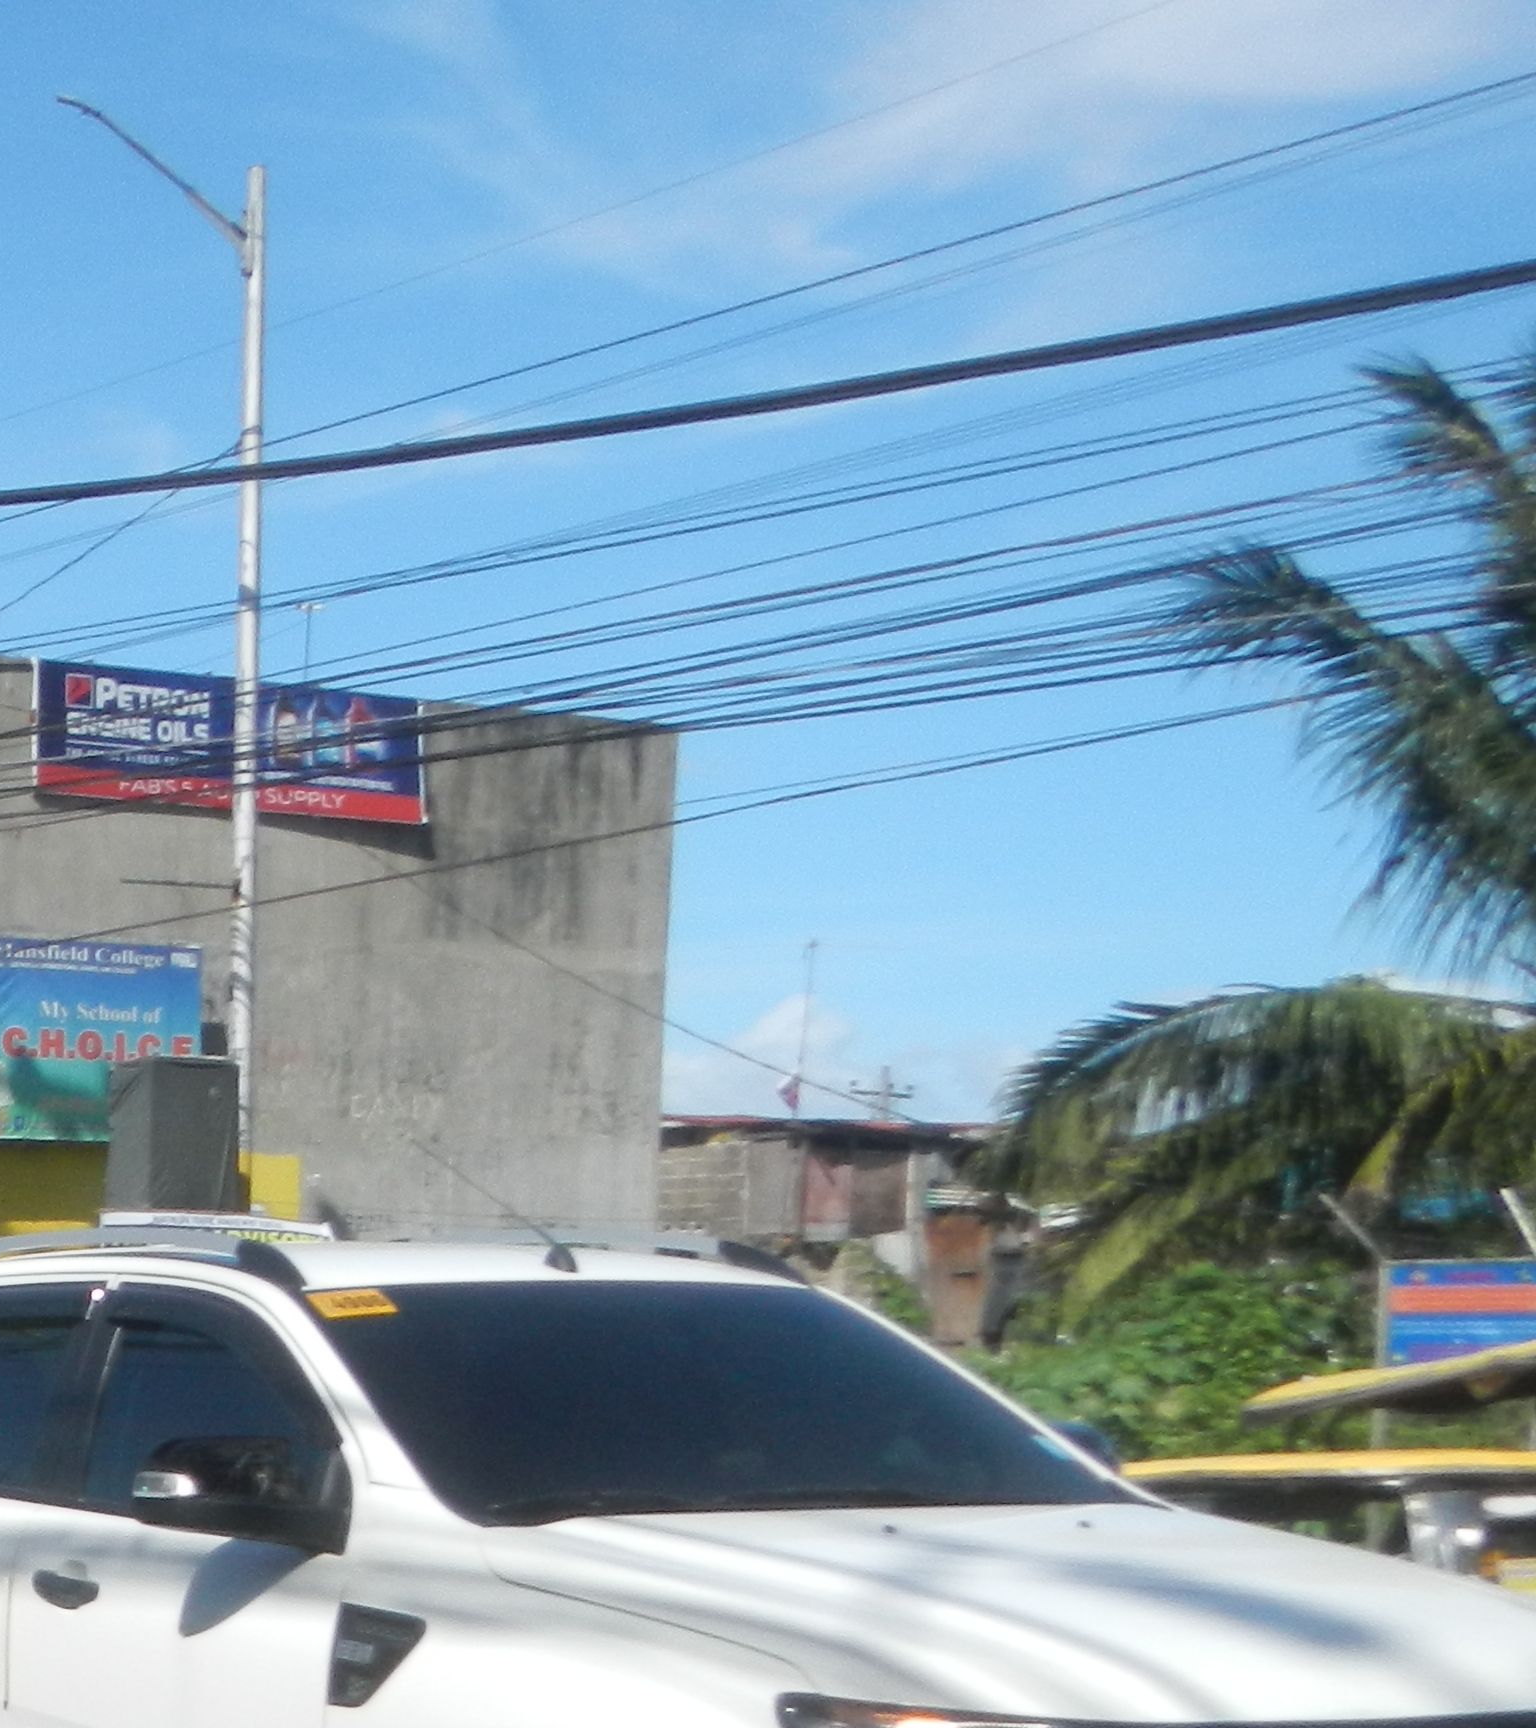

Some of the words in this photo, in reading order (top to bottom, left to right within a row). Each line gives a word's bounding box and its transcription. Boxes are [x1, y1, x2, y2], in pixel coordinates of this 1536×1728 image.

[96, 677, 210, 719] PETRON
[65, 711, 152, 741] ENGINE
[156, 720, 210, 744] OILS
[264, 787, 346, 809] SUPPLY
[95, 948, 165, 968] College
[39, 1000, 69, 1023] My
[77, 1003, 137, 1023] School
[141, 1007, 162, 1023] of
